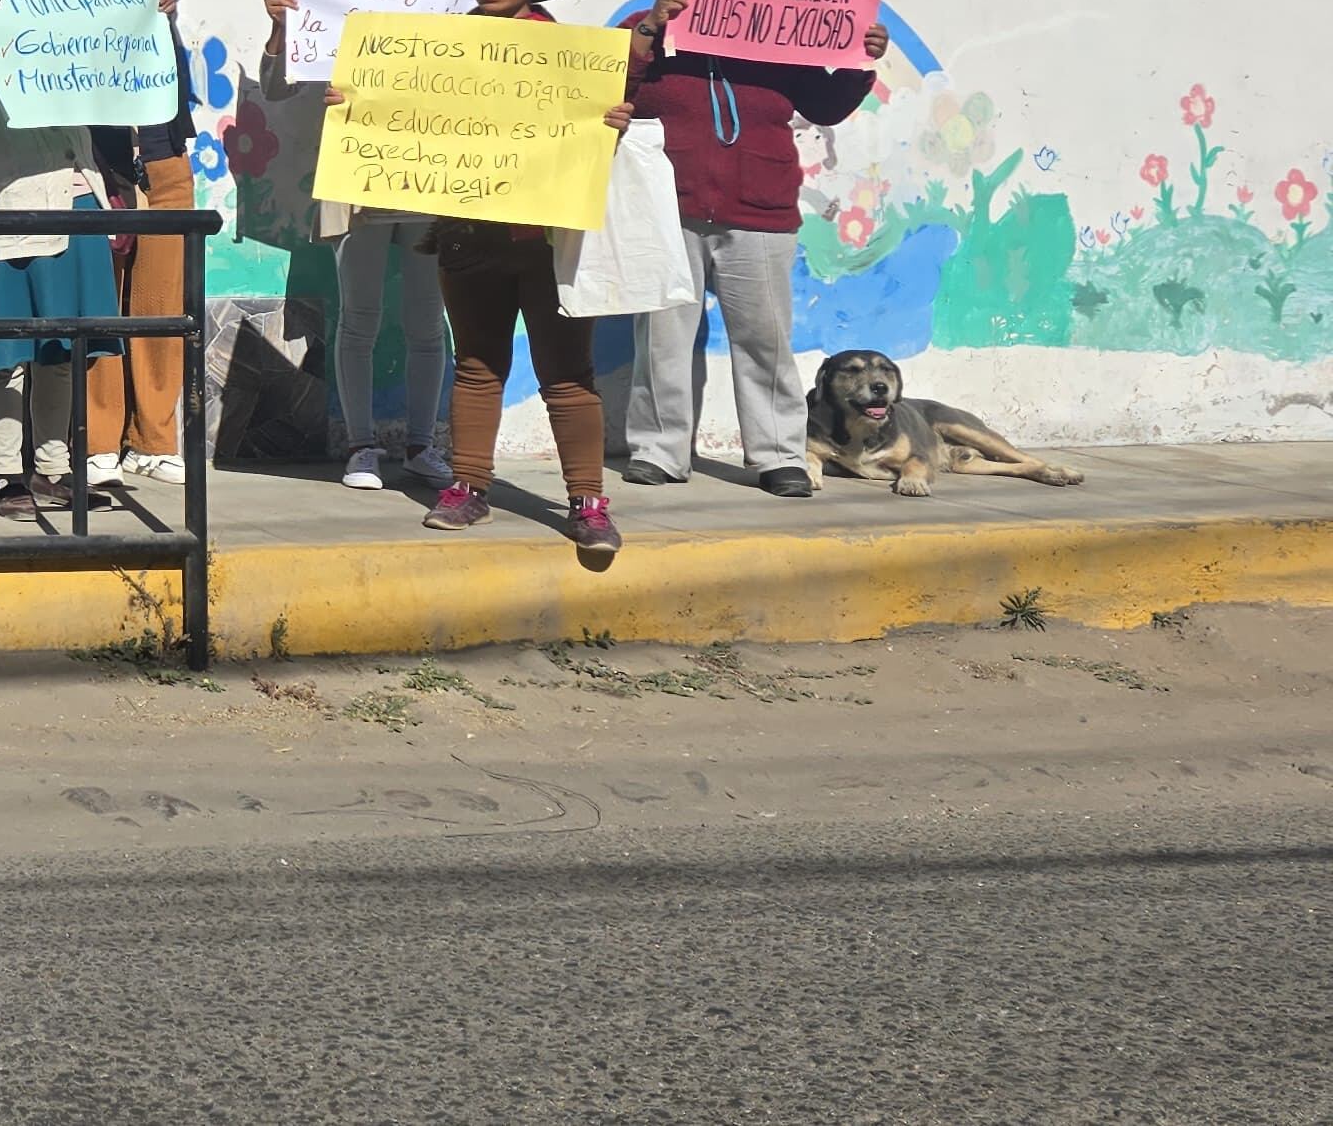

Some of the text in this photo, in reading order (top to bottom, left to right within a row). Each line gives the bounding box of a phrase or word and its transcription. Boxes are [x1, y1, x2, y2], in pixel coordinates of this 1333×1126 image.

[299, 9, 327, 33] la
[744, 1, 773, 44] NO
[775, 6, 856, 50] EXCUSAS
[15, 27, 159, 63] Gobierno Regional
[480, 41, 548, 67] niños
[557, 49, 627, 74] merecen
[108, 65, 122, 87] de
[392, 65, 505, 96] Educación
[344, 101, 576, 137] La Educación un
[494, 152, 518, 169] un
